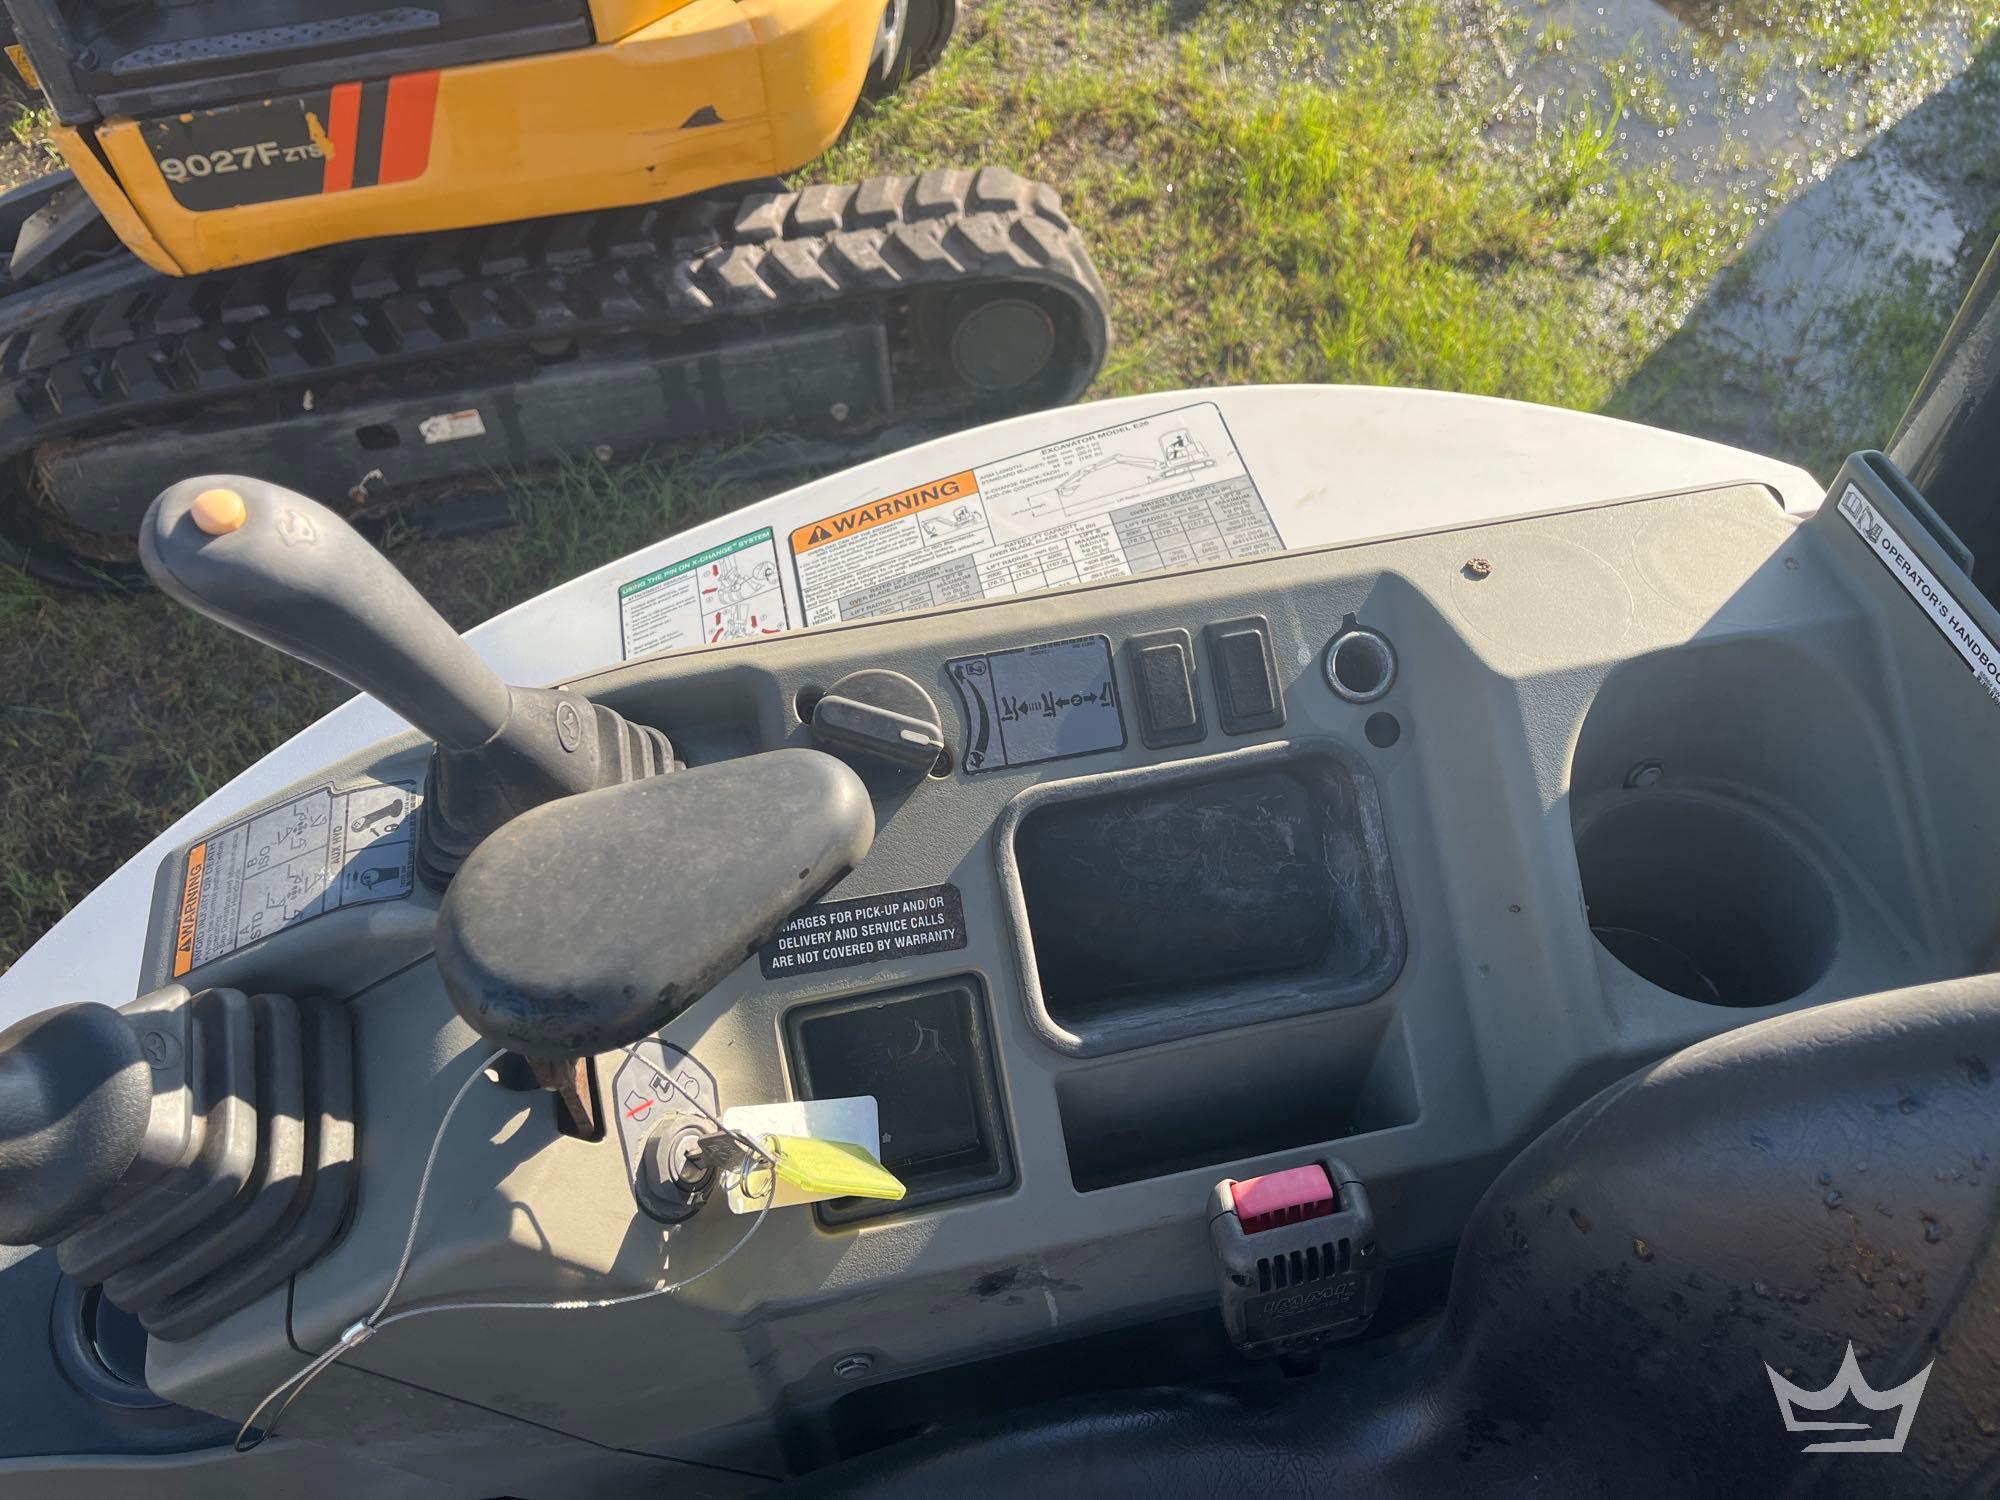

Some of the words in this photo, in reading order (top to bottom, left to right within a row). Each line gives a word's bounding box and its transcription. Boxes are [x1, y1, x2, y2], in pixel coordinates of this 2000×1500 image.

[1041, 435, 1095, 454] EXCAVATOR
[1097, 425, 1130, 438] MODEL
[1131, 420, 1149, 428] E26
[833, 481, 960, 532] WARNING
[622, 581, 646, 594] USING
[647, 574, 662, 584] THE
[663, 568, 676, 577] PIN
[678, 562, 690, 572] ON
[738, 530, 769, 547] SYSTEM
[1881, 538, 1949, 618] OPERATOR'S
[332, 824, 341, 845] HYD
[205, 842, 215, 875] DEATH
[247, 857, 257, 867] B
[257, 844, 270, 870] ISO
[331, 844, 340, 865] AUX
[202, 875, 211, 892] OR
[180, 862, 202, 940] WARNING
[198, 892, 209, 930] INJURY
[783, 914, 826, 931] ARGES
[829, 910, 852, 924] FOR
[855, 903, 899, 920] PICK-UP
[902, 896, 944, 913] AND/OR
[239, 924, 249, 936] A
[250, 910, 263, 940] STD
[779, 930, 831, 949] DELIVERY
[834, 926, 857, 940] AND
[860, 919, 907, 936] SERVICE
[910, 913, 944, 929] CALLS
[193, 930, 204, 962] AVOID
[773, 953, 793, 967] ARE
[796, 949, 819, 963] NOT
[822, 941, 873, 959] COVERED
[876, 938, 890, 951] BY
[893, 928, 955, 948] WARRANTY
